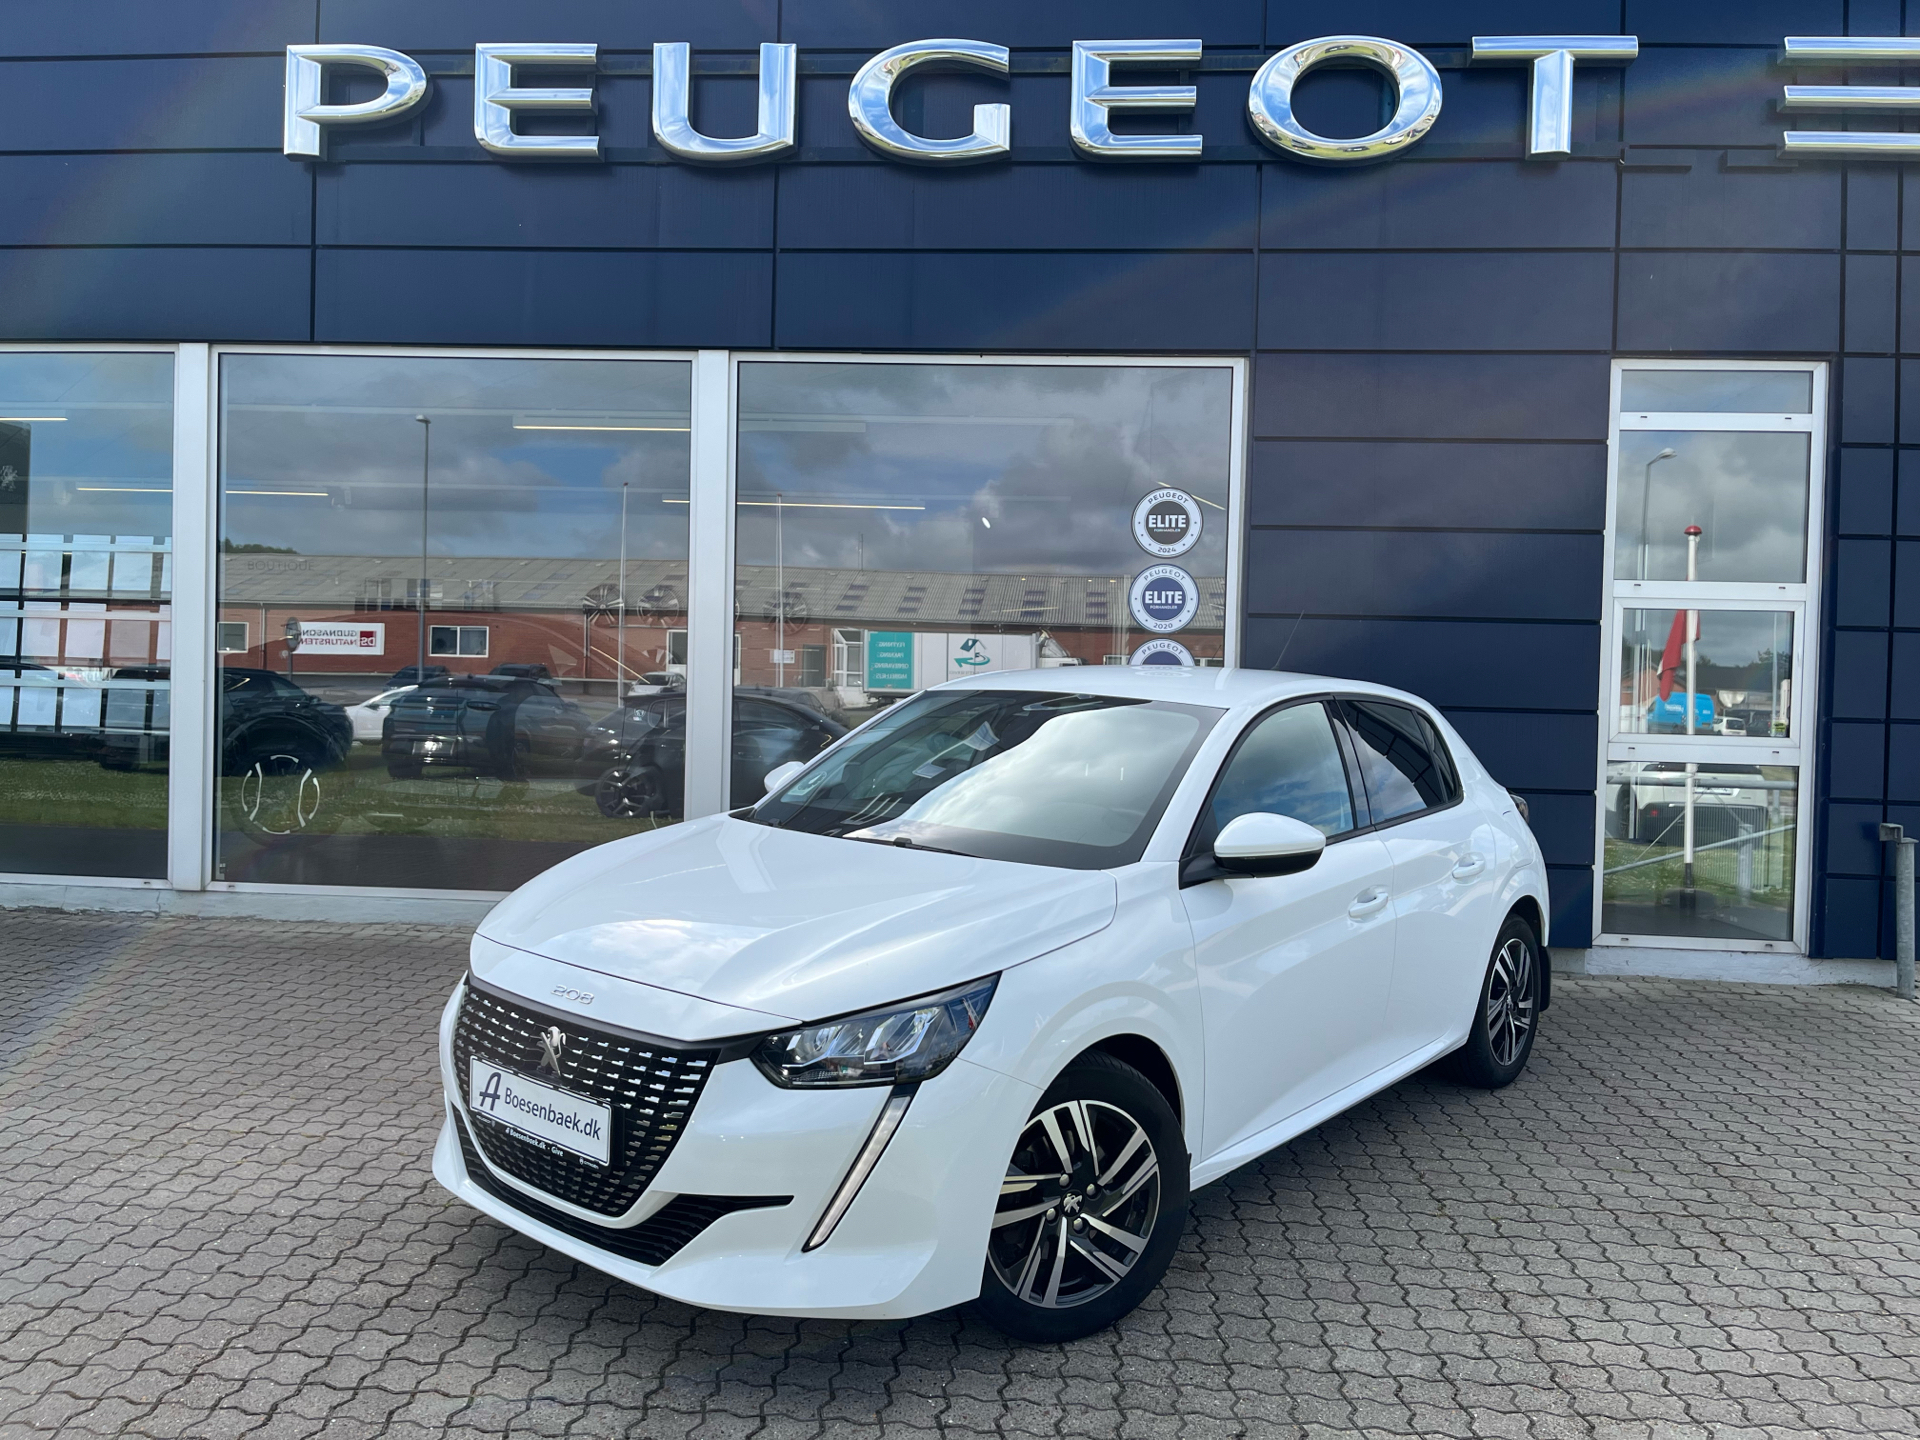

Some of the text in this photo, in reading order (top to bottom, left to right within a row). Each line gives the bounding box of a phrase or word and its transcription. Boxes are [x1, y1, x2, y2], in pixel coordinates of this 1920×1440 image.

[283, 35, 1640, 161] PEUGEOT
[1147, 491, 1189, 505] PEUGEOT
[1148, 514, 1187, 528] ELITE
[1157, 546, 1177, 554] 2024
[247, 560, 315, 571] BOUTIQUE
[1143, 568, 1187, 581] PEUGEOT
[1144, 590, 1183, 604] ELITE
[1152, 622, 1174, 630] 2020
[1141, 642, 1184, 656] PEUGEOT
[550, 983, 595, 1005] 208
[504, 1086, 601, 1141] Boesenbaek.dk
[510, 1128, 546, 1150] Boesenbaek.dk
[551, 1146, 564, 1157] Give
